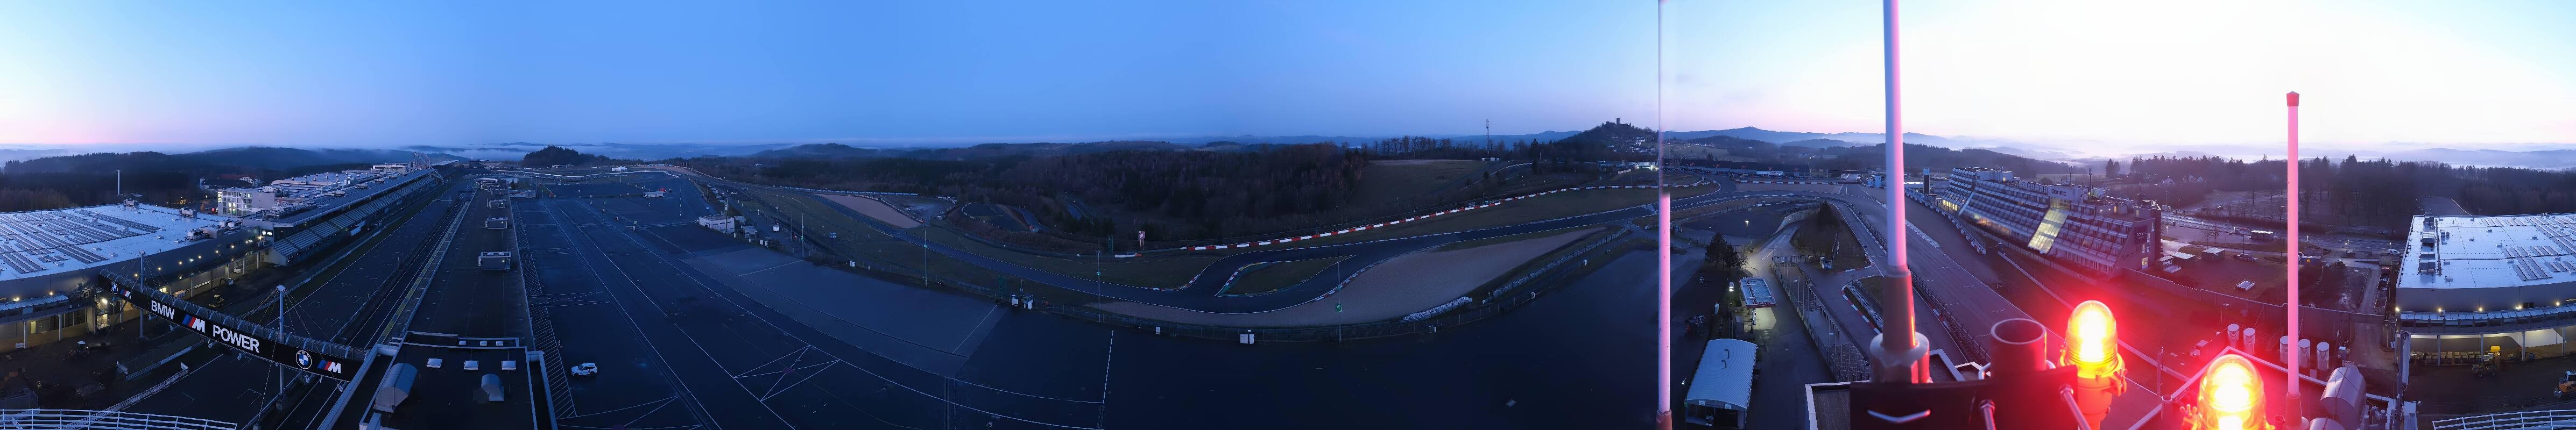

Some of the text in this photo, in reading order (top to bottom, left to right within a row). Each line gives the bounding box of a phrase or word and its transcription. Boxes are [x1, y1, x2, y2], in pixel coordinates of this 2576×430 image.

[2051, 188, 2066, 196] Dorint
[151, 299, 260, 354] BMW M POWER
[327, 361, 342, 374] M
